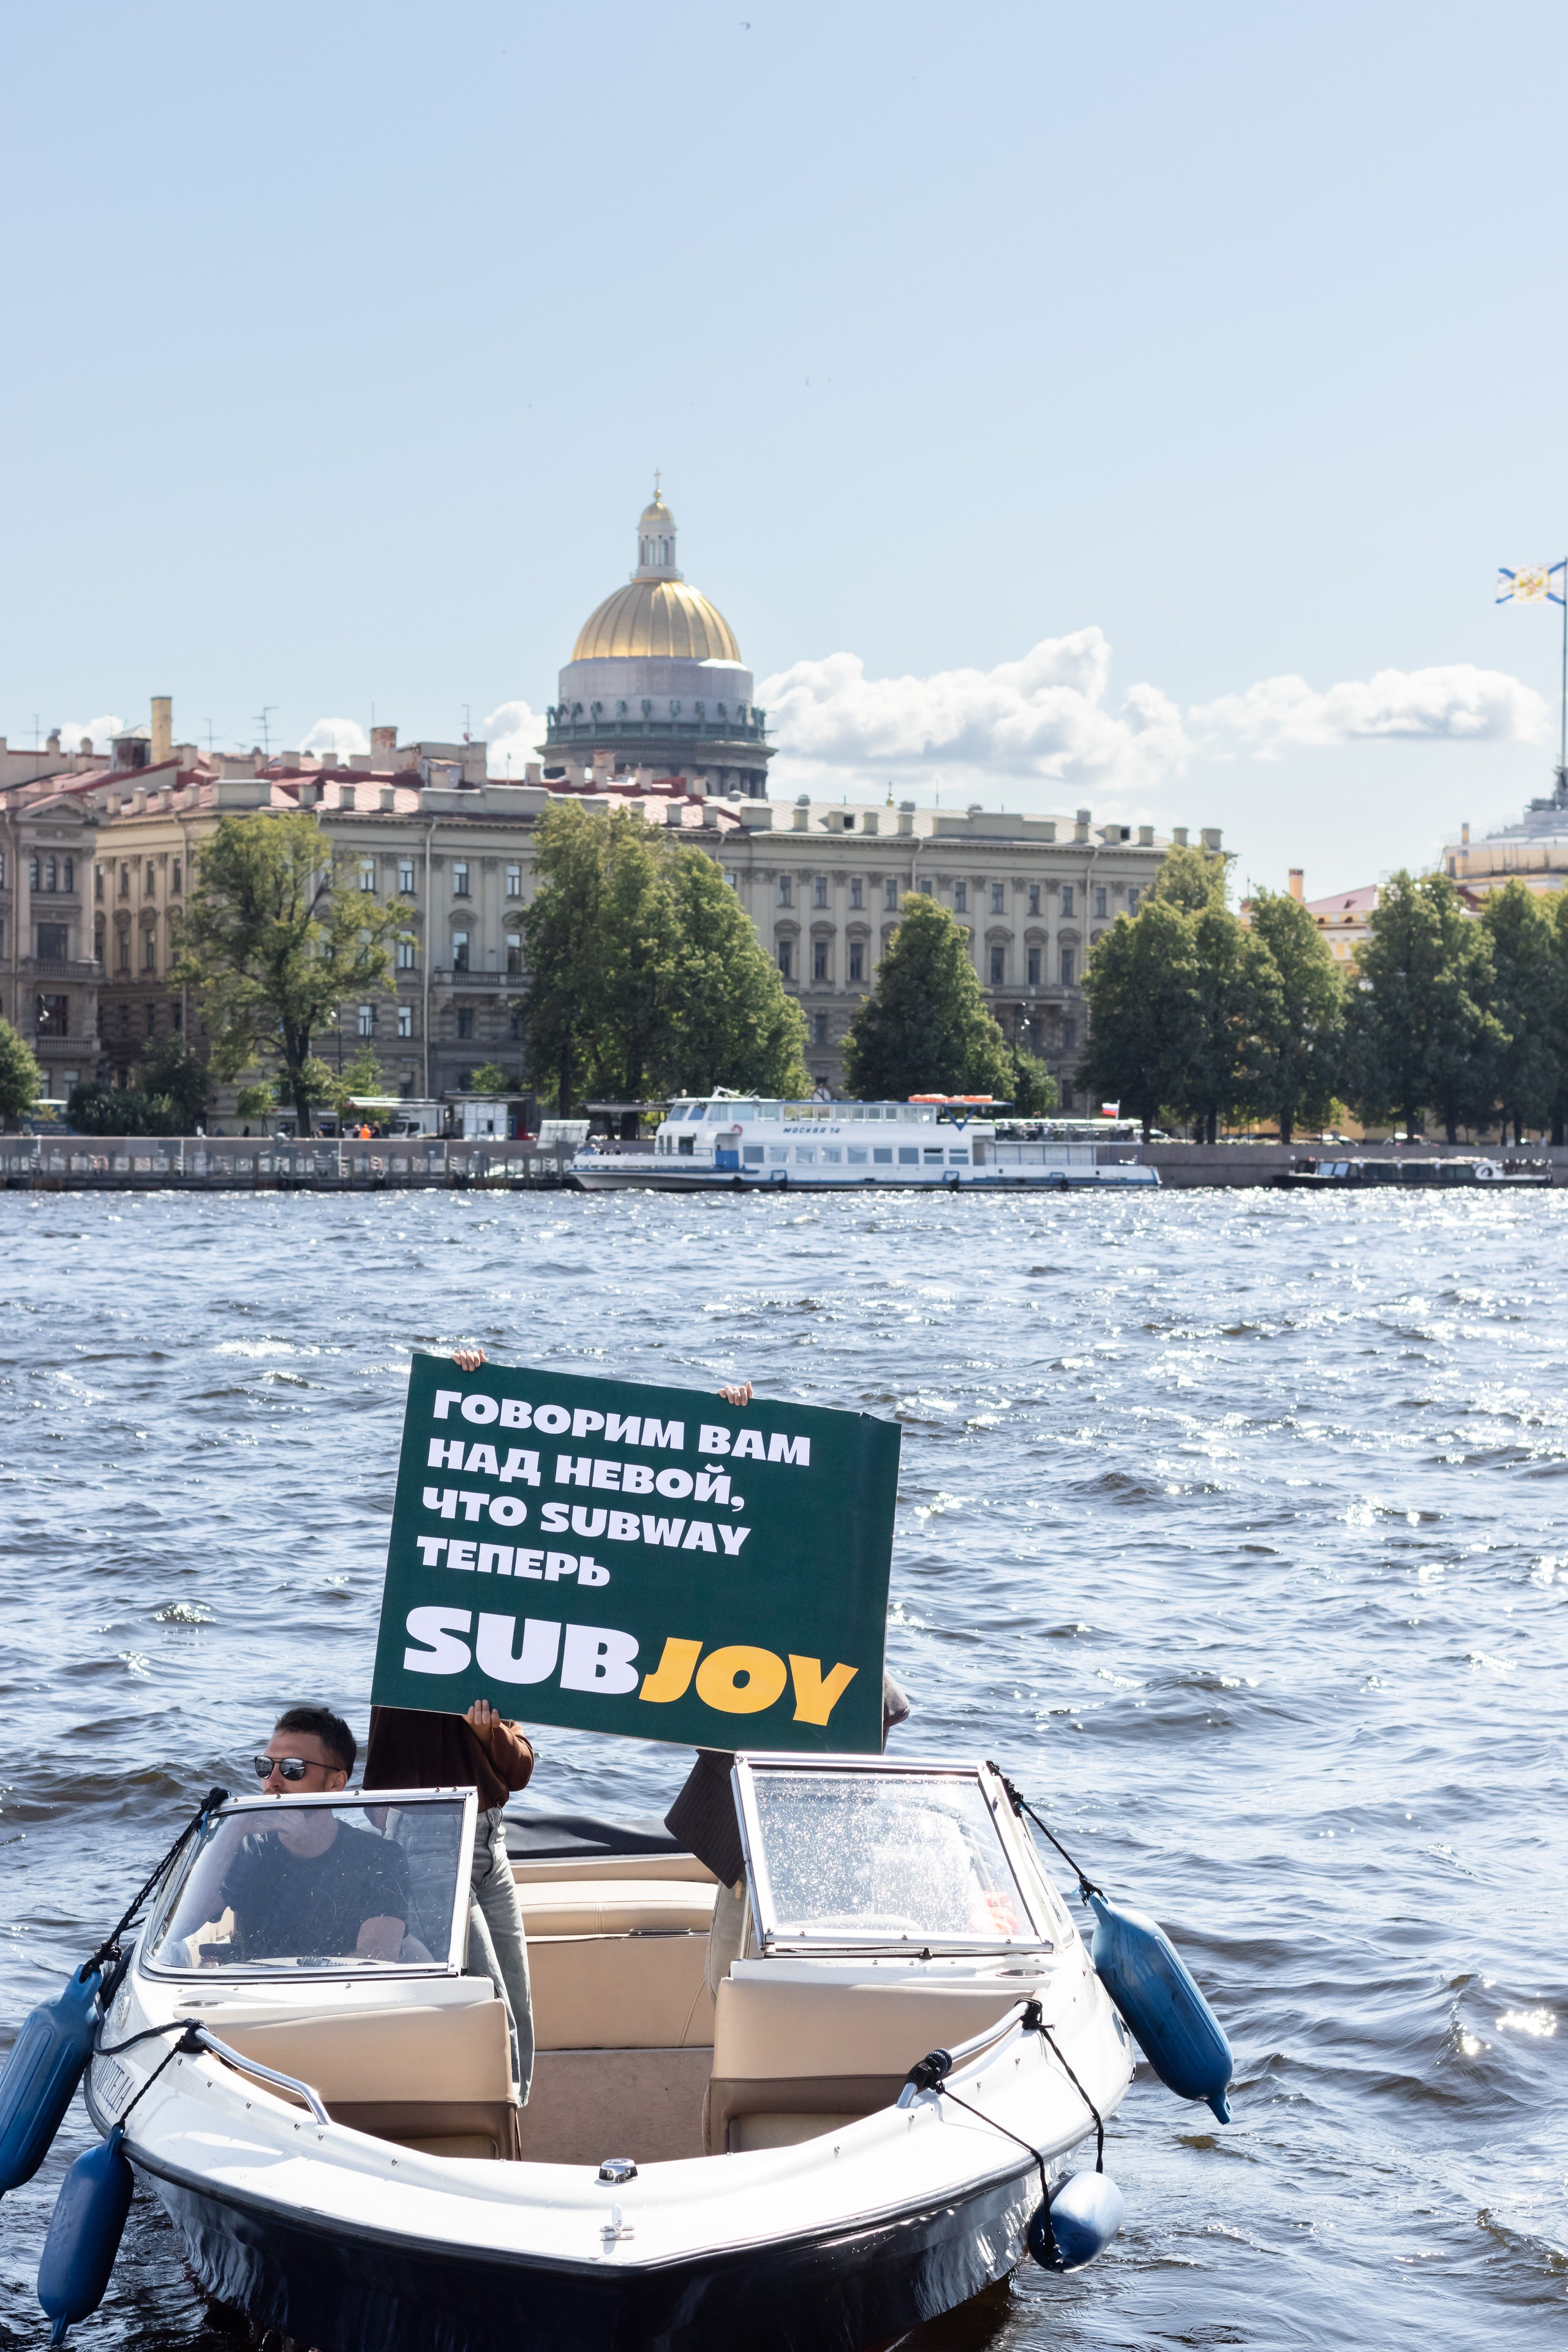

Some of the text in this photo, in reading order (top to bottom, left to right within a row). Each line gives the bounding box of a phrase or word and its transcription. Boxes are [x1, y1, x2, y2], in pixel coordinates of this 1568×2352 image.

[433, 1389, 810, 1466] ГОВОРИМ ВАМ
[427, 1438, 745, 1512] НАД НЕВОЙ,
[423, 1487, 752, 1556] ЧТО SUBWAY
[417, 1536, 610, 1586] ТЕПЕРЬ
[403, 1606, 859, 1726] SUBJOY
